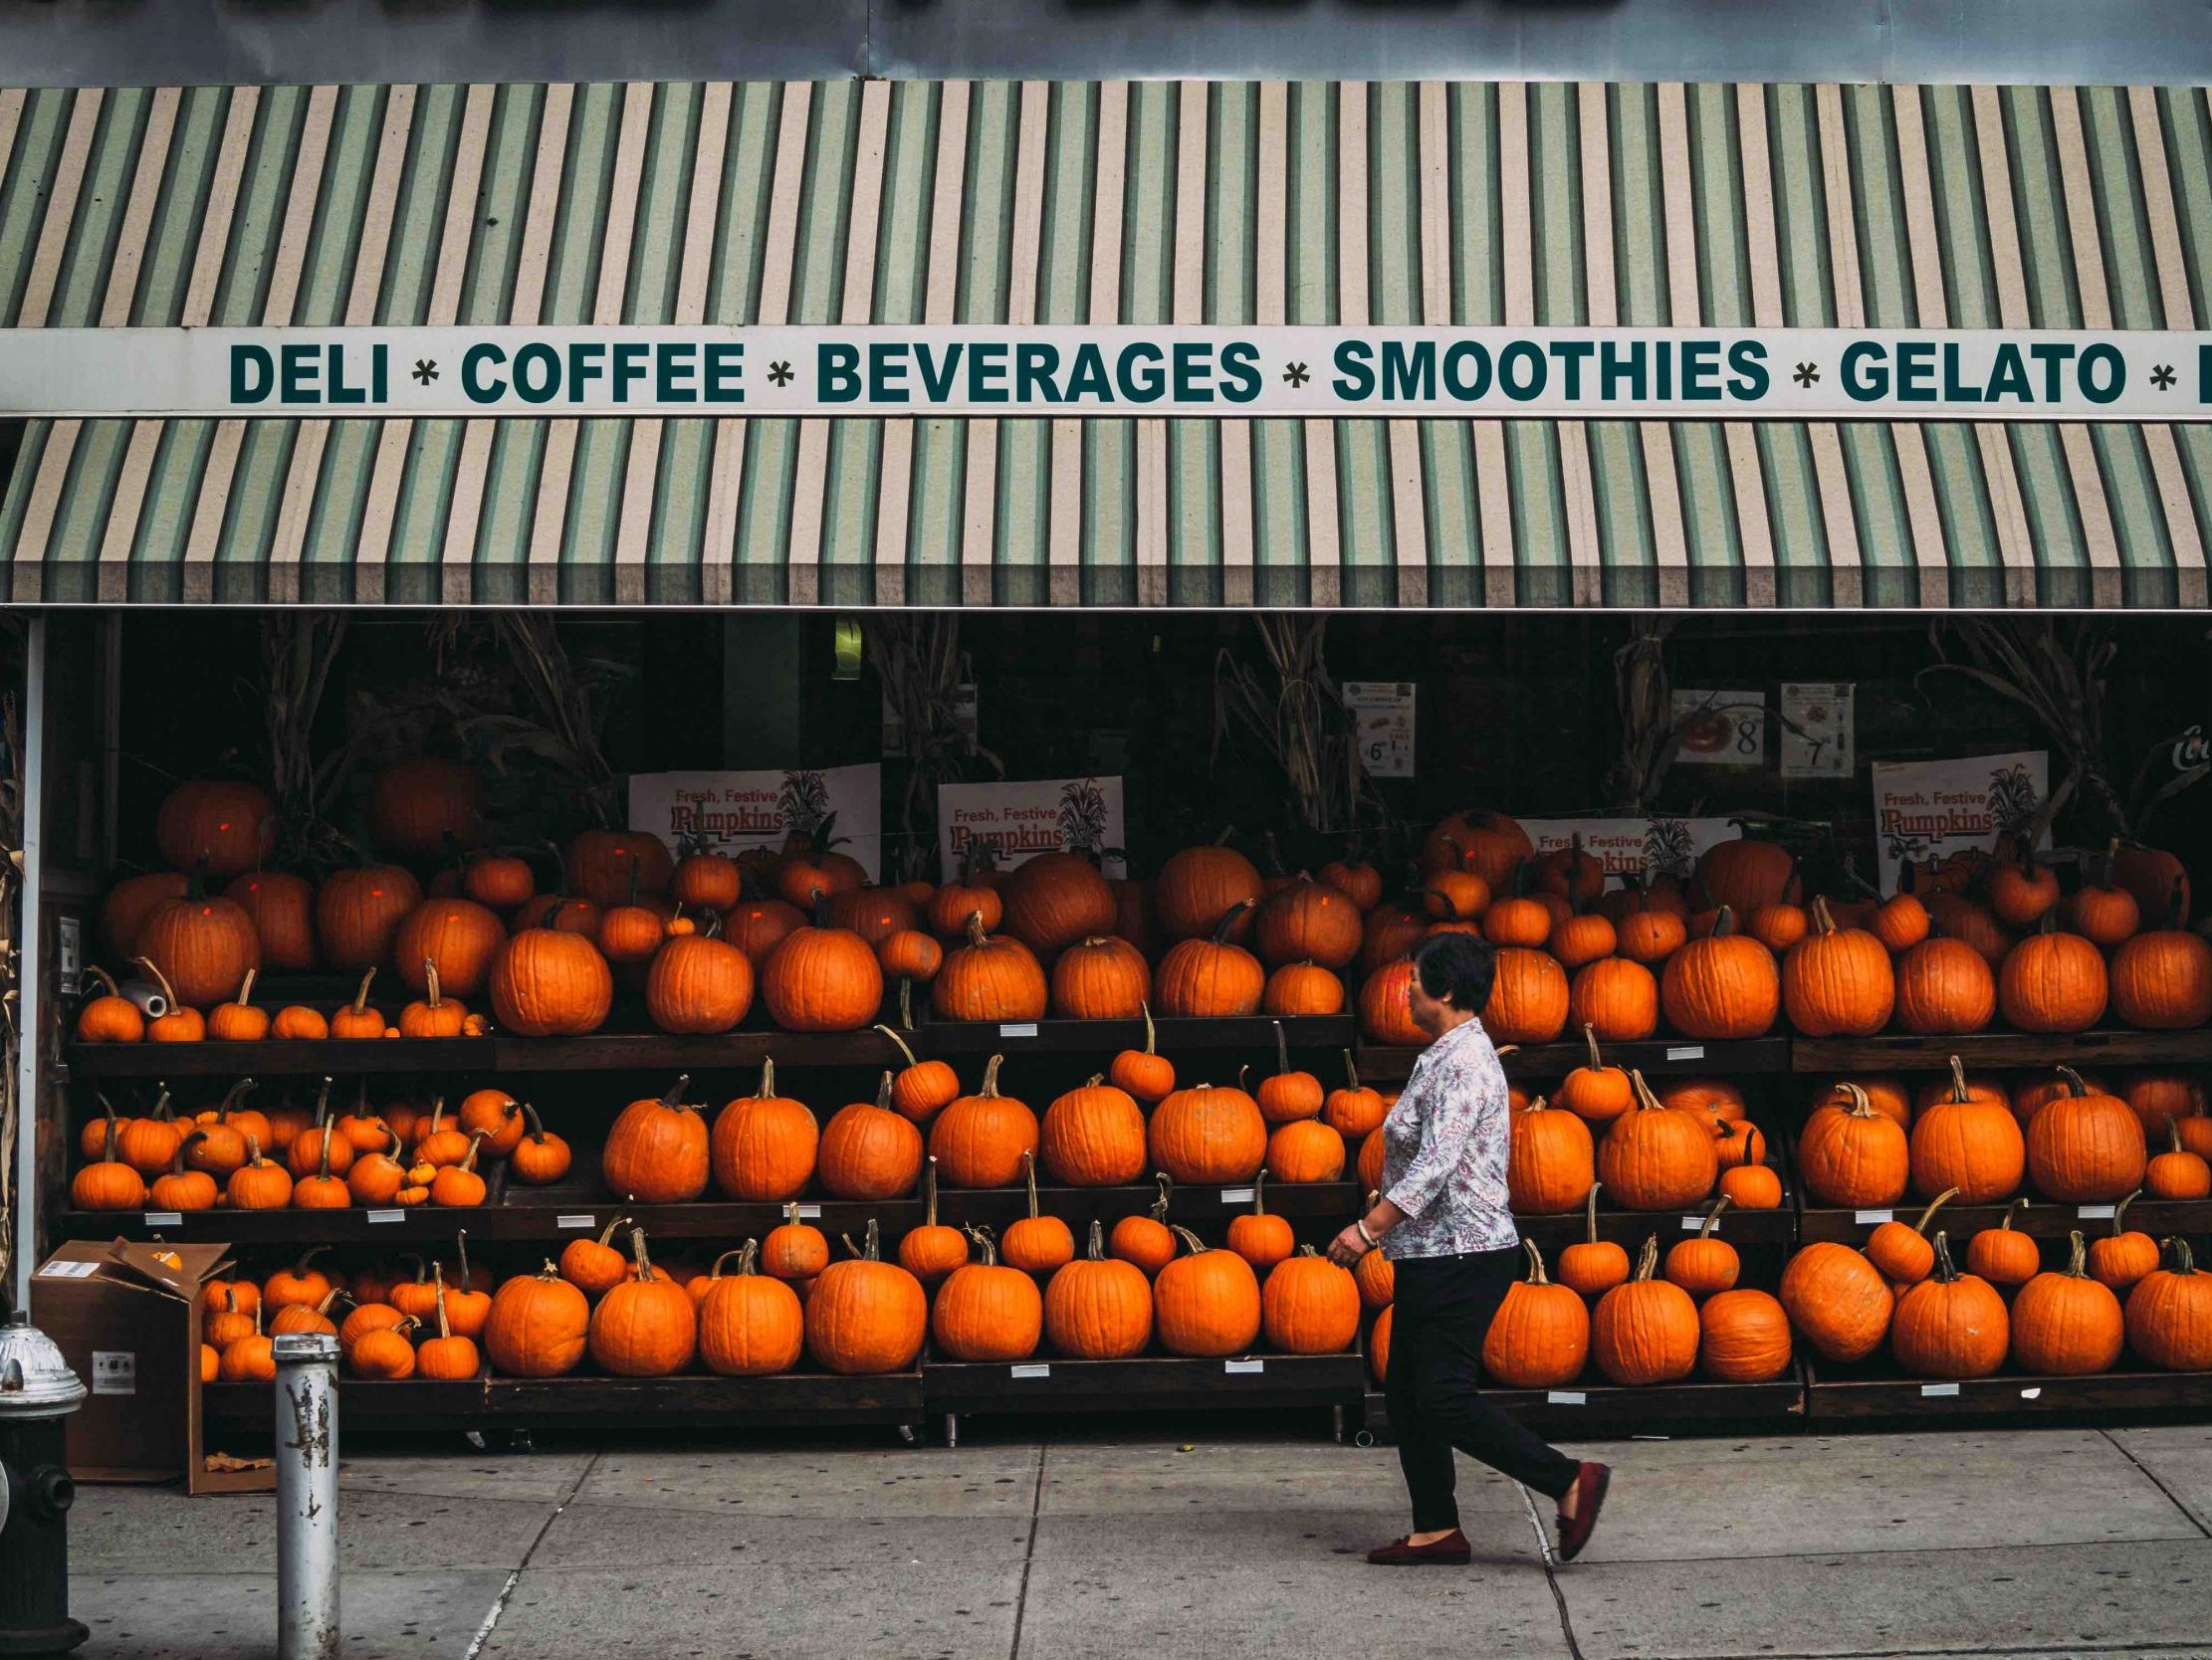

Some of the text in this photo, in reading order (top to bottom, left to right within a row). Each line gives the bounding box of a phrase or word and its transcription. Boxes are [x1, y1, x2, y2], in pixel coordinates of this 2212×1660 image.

[230, 343, 388, 404] DELI
[461, 342, 745, 404] COFFEE
[817, 341, 1262, 403] BEVERAGES
[1332, 339, 1770, 402] SMOOTHIES
[1840, 340, 2126, 404] GELATO
[676, 788, 777, 804] Fresh, Festive
[1884, 791, 1986, 807] Fresh, Festive
[955, 806, 1056, 823] Fresh, Festive
[1883, 809, 1993, 839] Pumpkins
[1540, 834, 1643, 849] Fres, Festive
